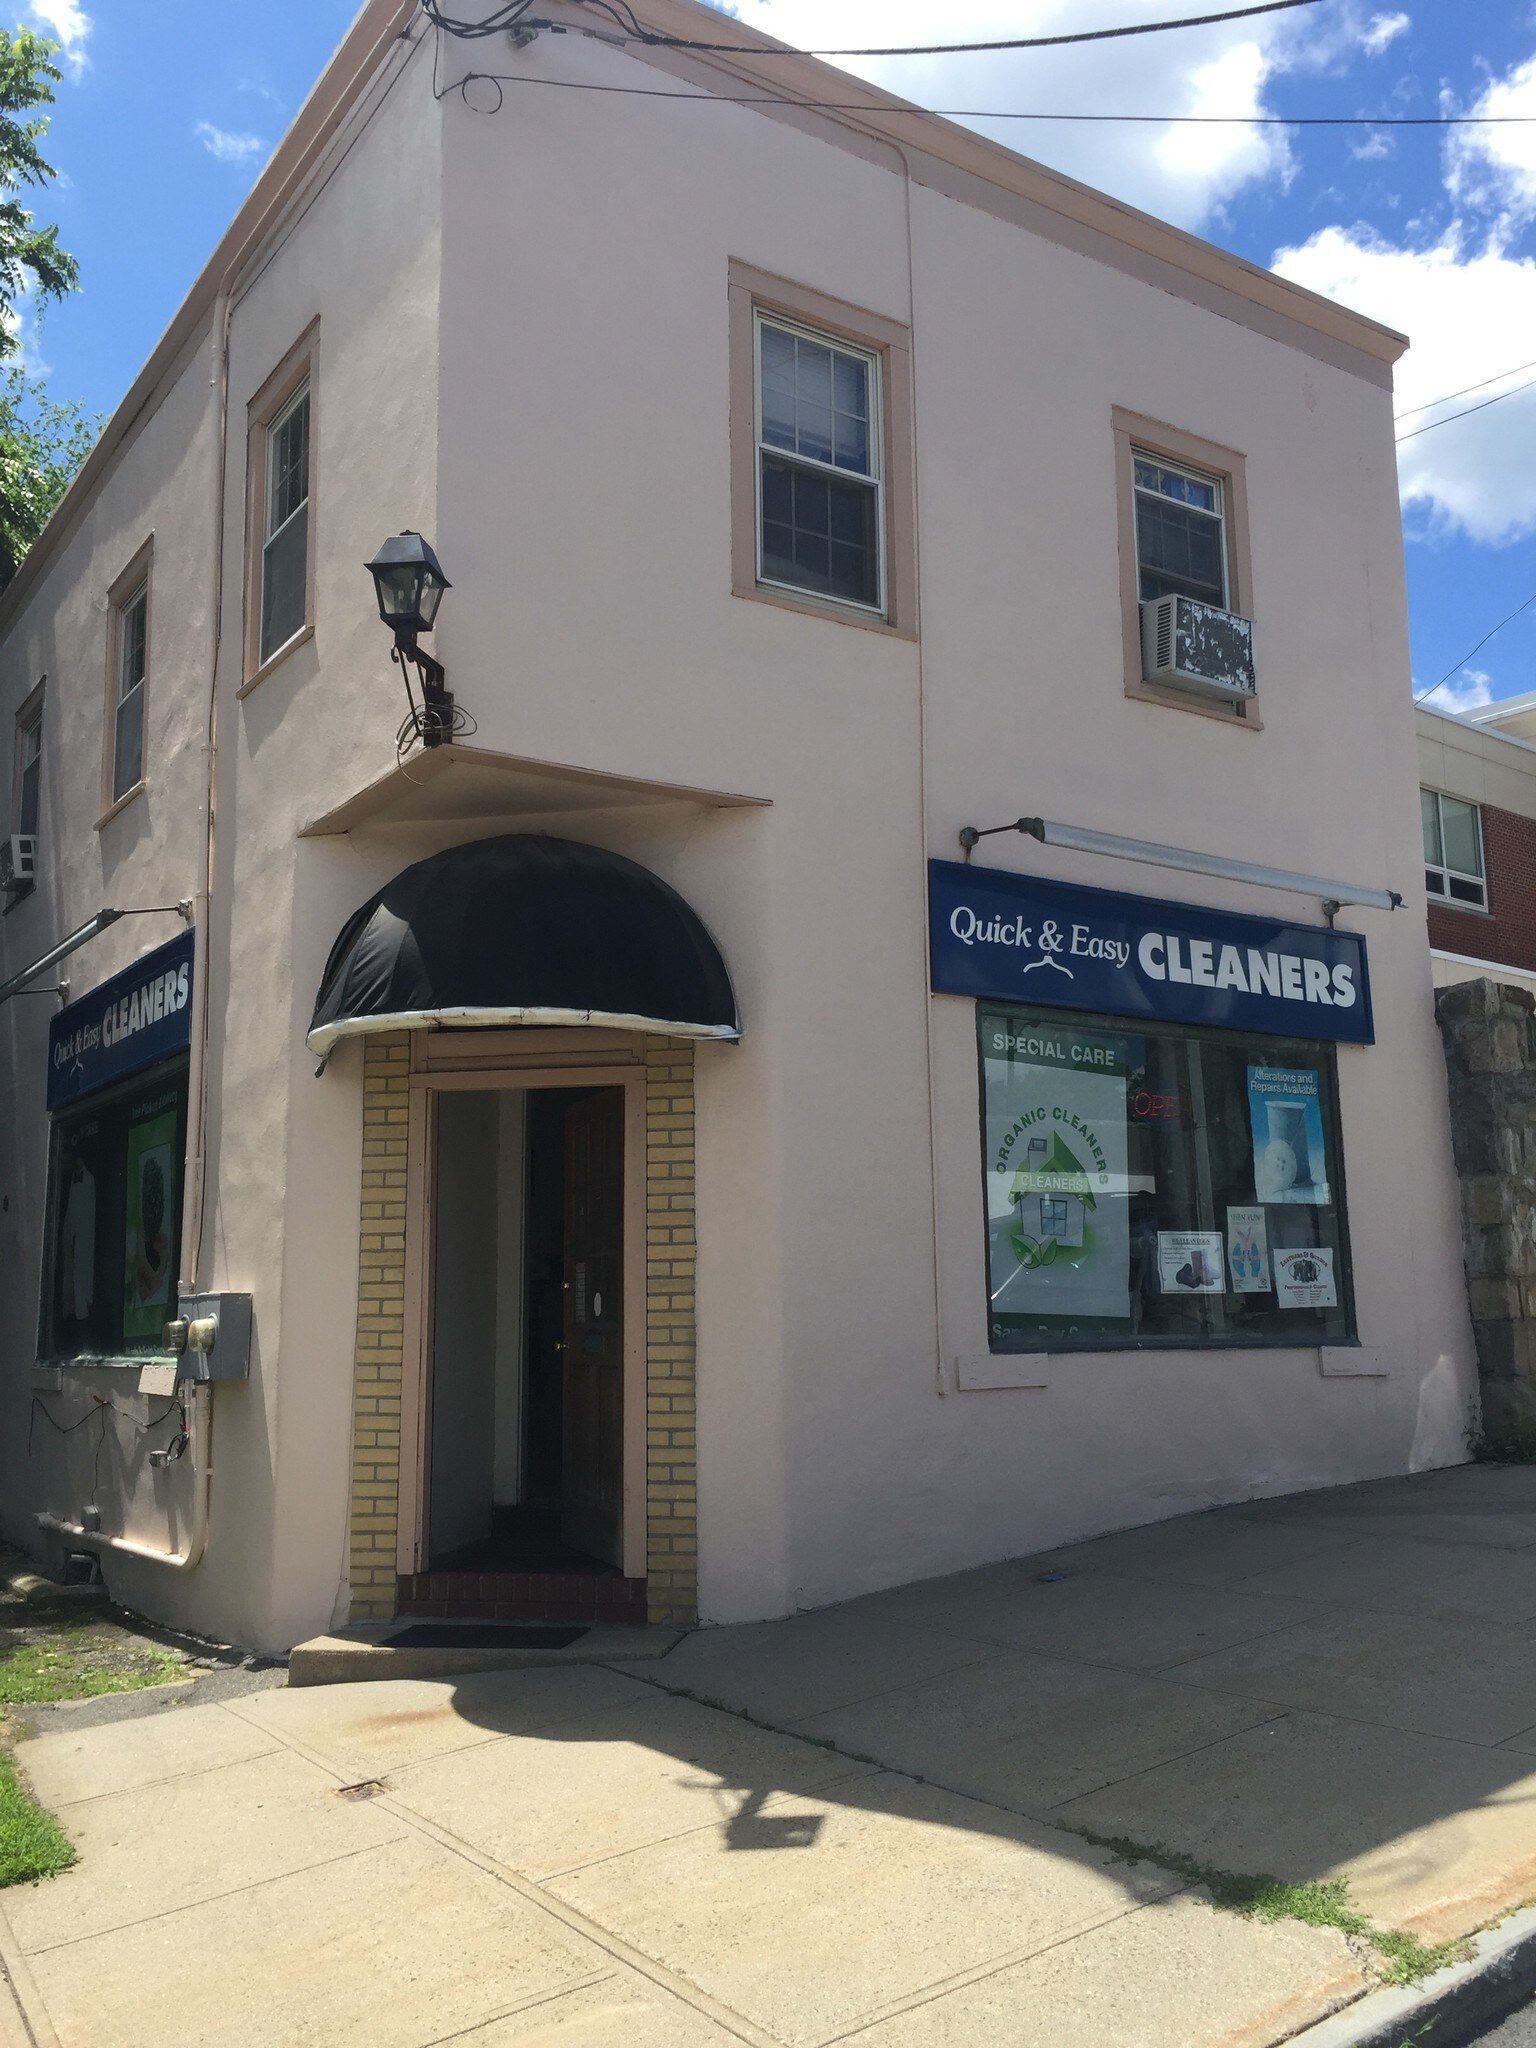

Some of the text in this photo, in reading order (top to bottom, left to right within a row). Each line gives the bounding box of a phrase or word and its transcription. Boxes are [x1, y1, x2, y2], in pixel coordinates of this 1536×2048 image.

[950, 906, 1357, 1008] Quick & Easy CLEANERS
[54, 962, 189, 1069] Quick & Easy CLEANERS
[992, 1033, 1115, 1067] SPECIAL CARE
[1250, 1080, 1318, 1095] Repairs Available
[1254, 1068, 1313, 1083] Alterations and
[996, 1107, 1109, 1185] ORGANIC CLEANERS
[1020, 1174, 1084, 1191] CLEANERS
